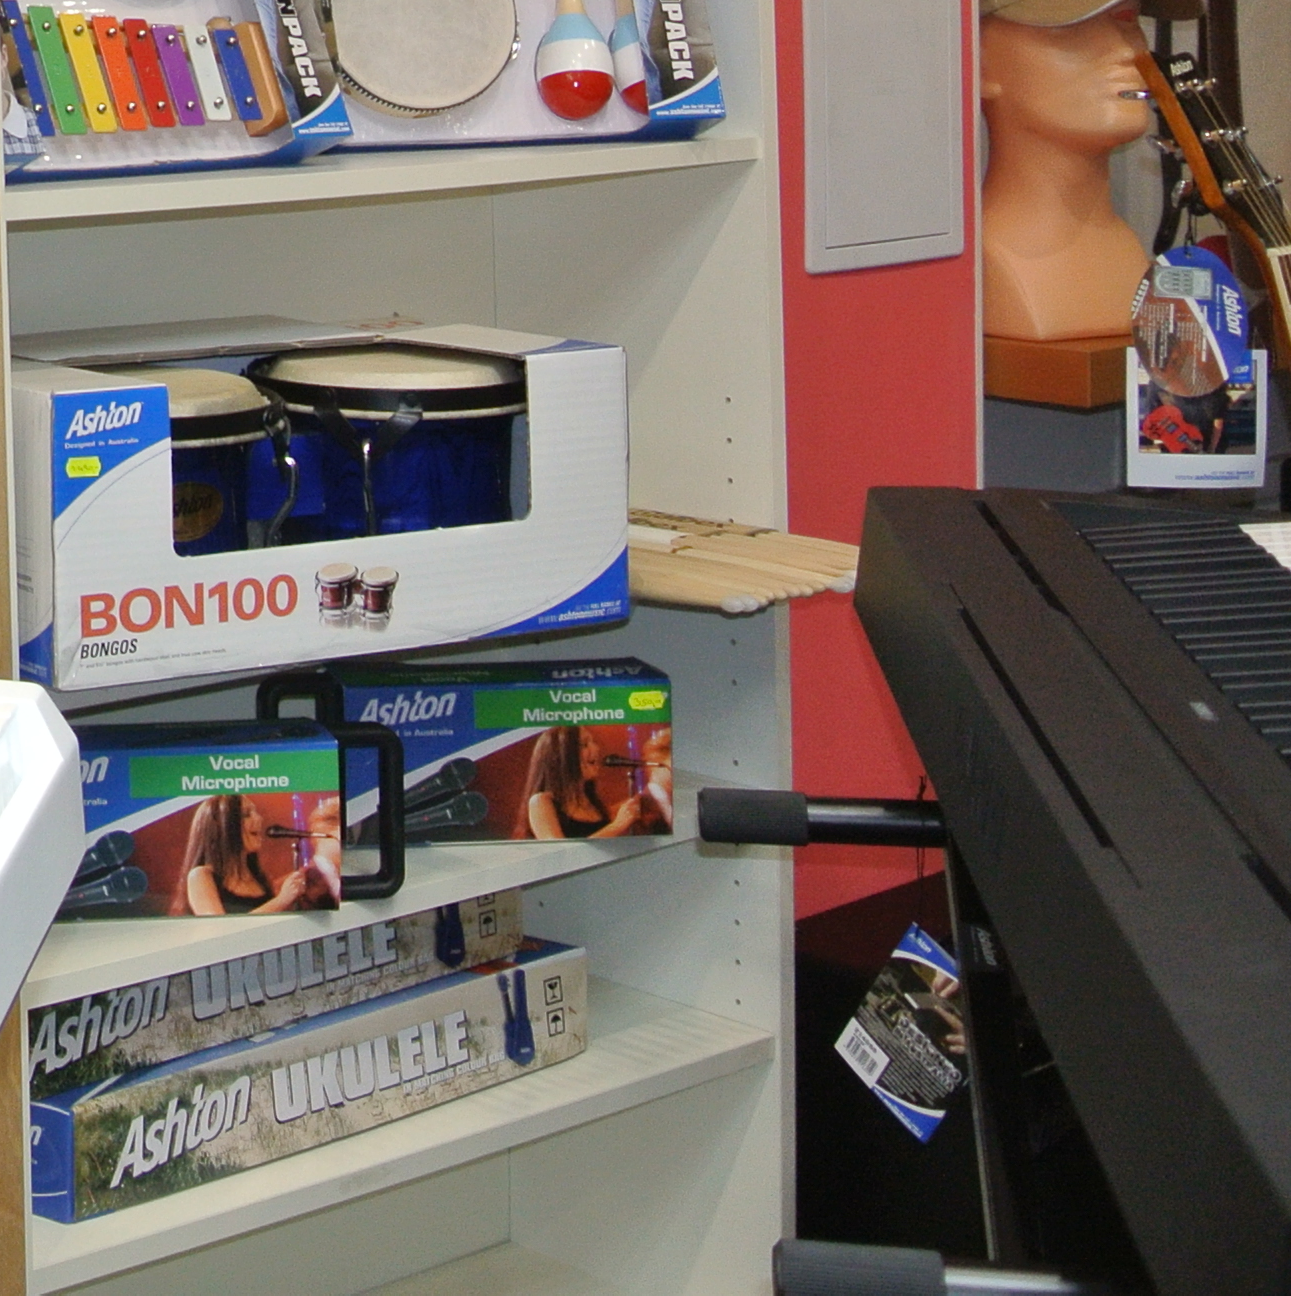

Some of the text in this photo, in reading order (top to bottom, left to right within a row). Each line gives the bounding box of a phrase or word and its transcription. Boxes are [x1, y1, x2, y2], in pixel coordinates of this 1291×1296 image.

[1169, 59, 1194, 77] Ashton
[1221, 284, 1241, 336] Ashton
[64, 400, 143, 441] Ashton
[64, 437, 140, 451] Designed Australia
[79, 573, 299, 640] BON100
[79, 638, 139, 661] BONGOS
[360, 690, 459, 727] Ashton
[548, 688, 597, 703] Vocal
[522, 706, 626, 724] Microphone
[208, 753, 261, 771] Vocal
[180, 772, 291, 792] Microphone
[29, 975, 170, 1081] Ashton
[271, 1009, 473, 1125] UKULELE
[109, 1074, 252, 1189] Ashton
